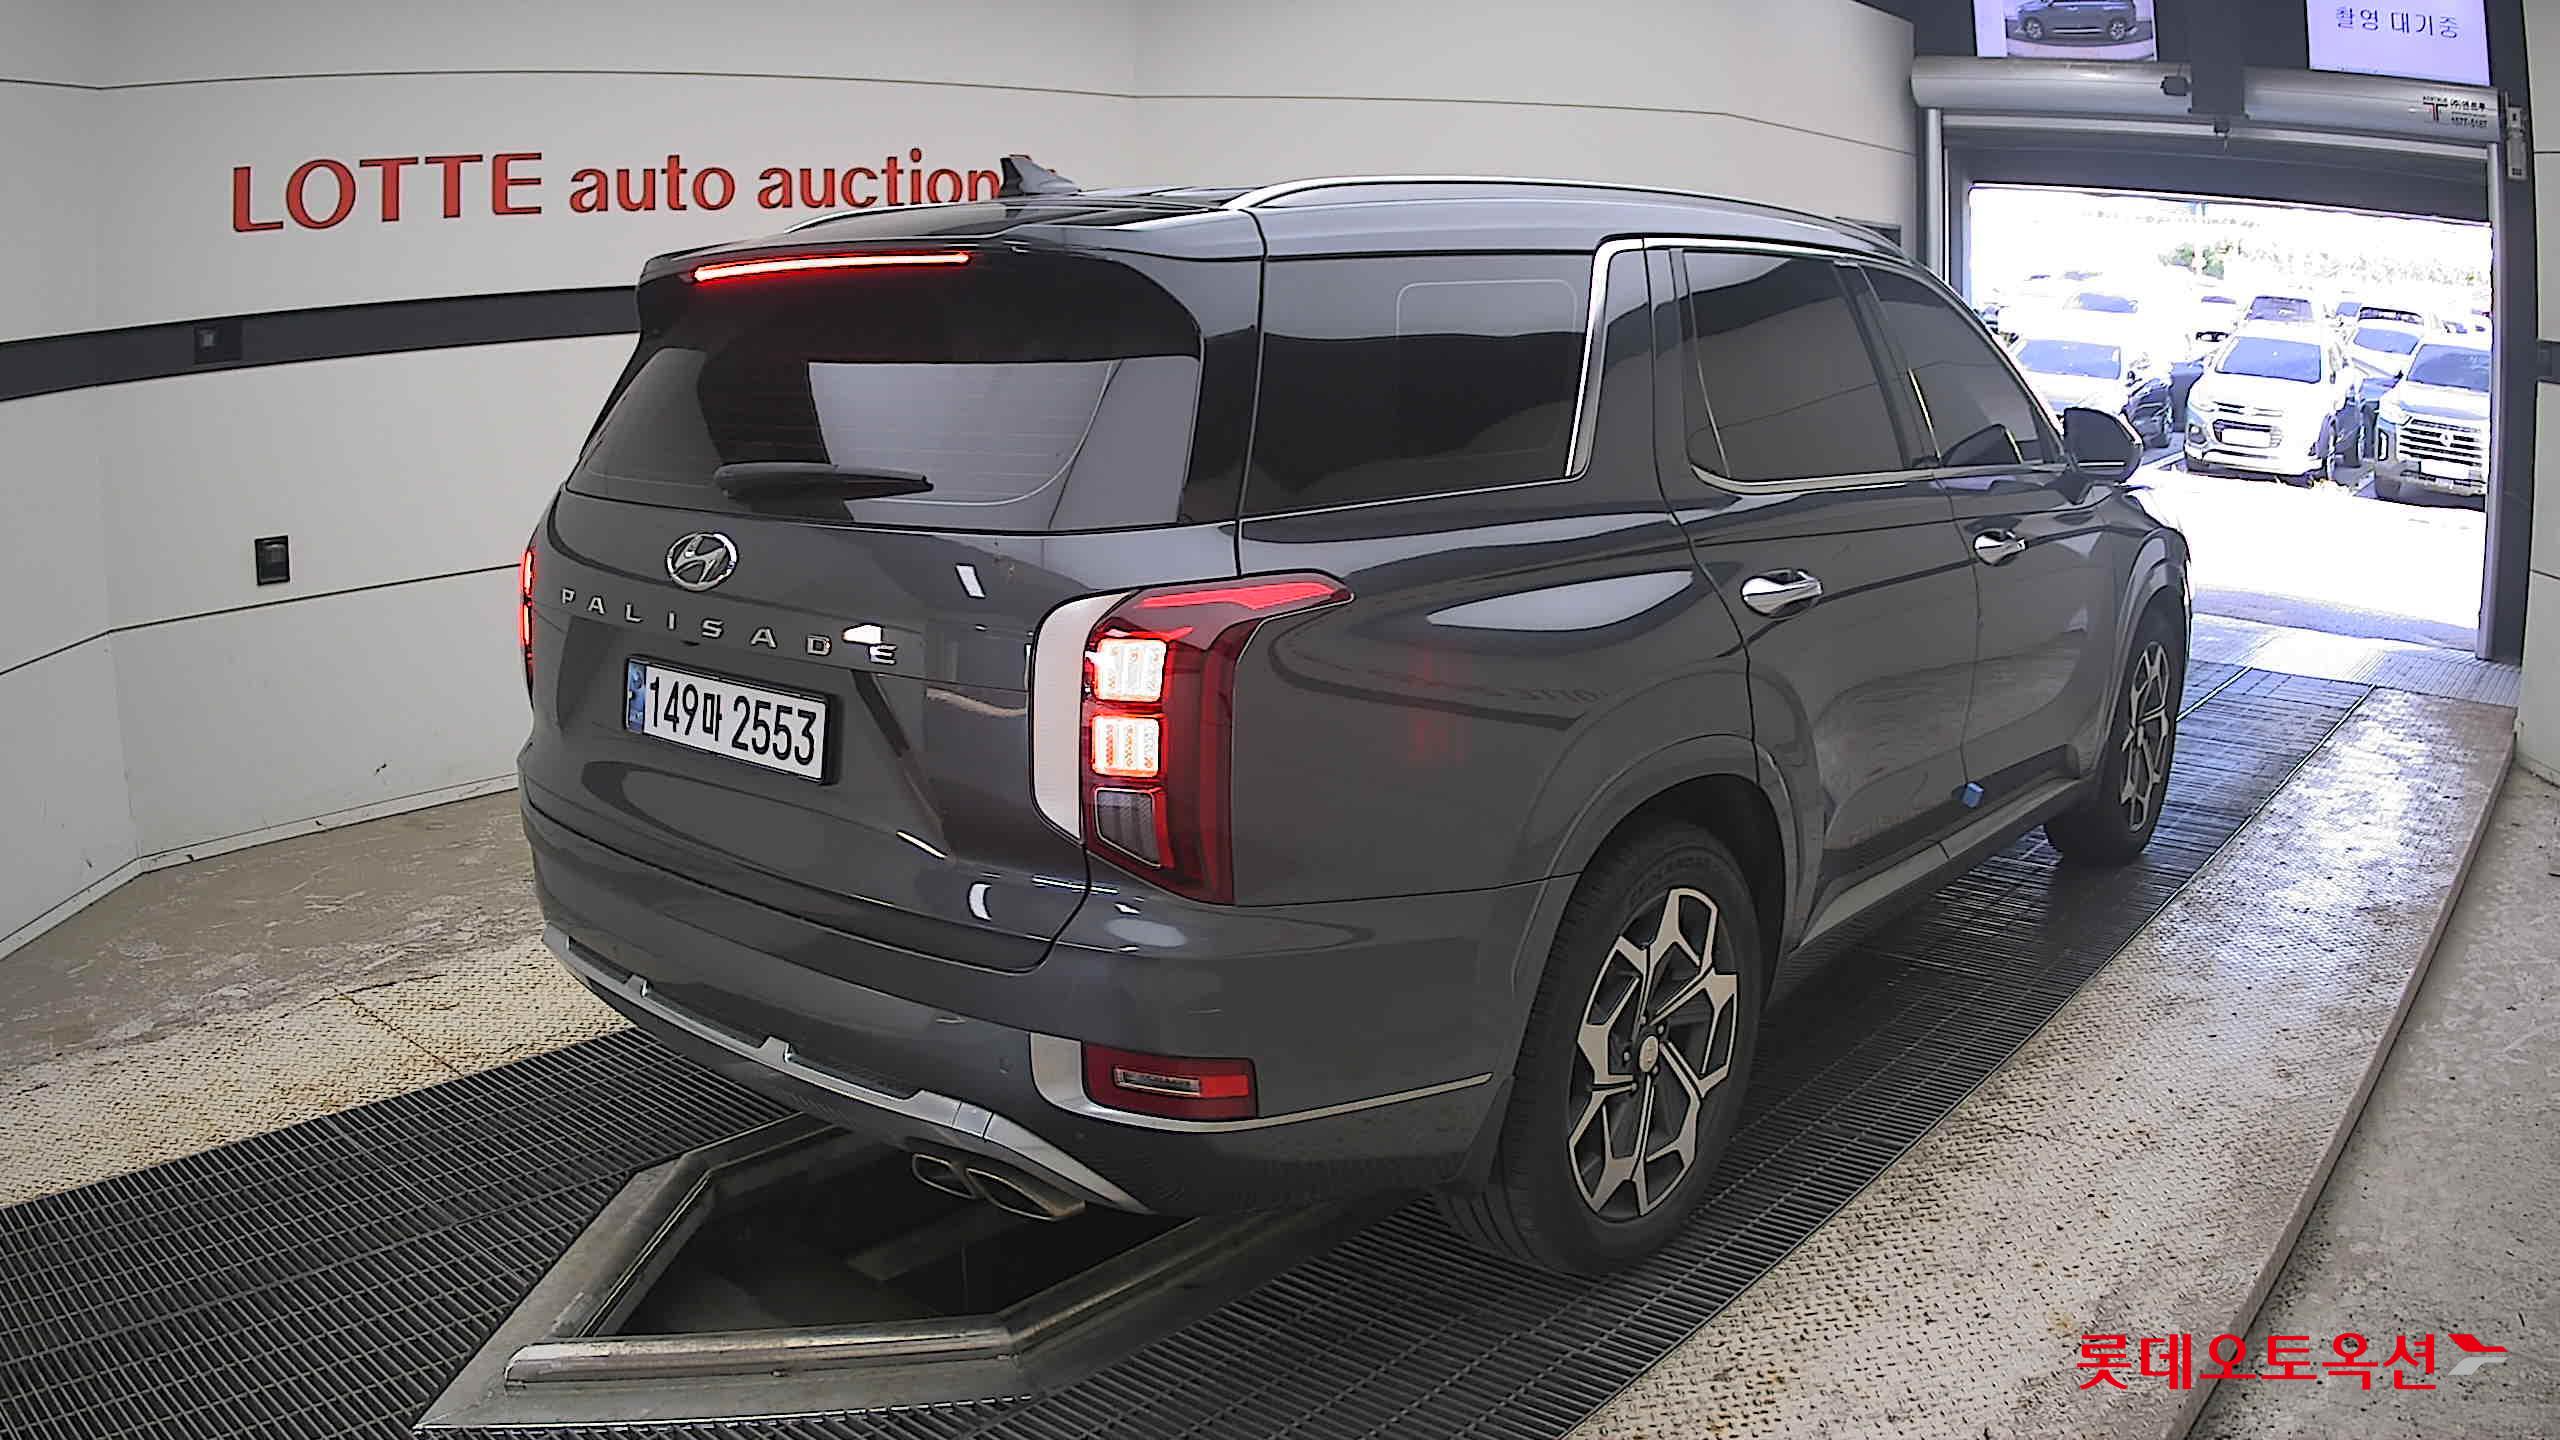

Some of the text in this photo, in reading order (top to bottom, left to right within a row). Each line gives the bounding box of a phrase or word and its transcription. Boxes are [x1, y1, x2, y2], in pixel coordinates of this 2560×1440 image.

[2336, 6, 2461, 39] 촬영 대기중
[232, 147, 1000, 233] LOTTE auto auction
[560, 587, 897, 665] PALISADE
[649, 676, 818, 766] 149마 2553
